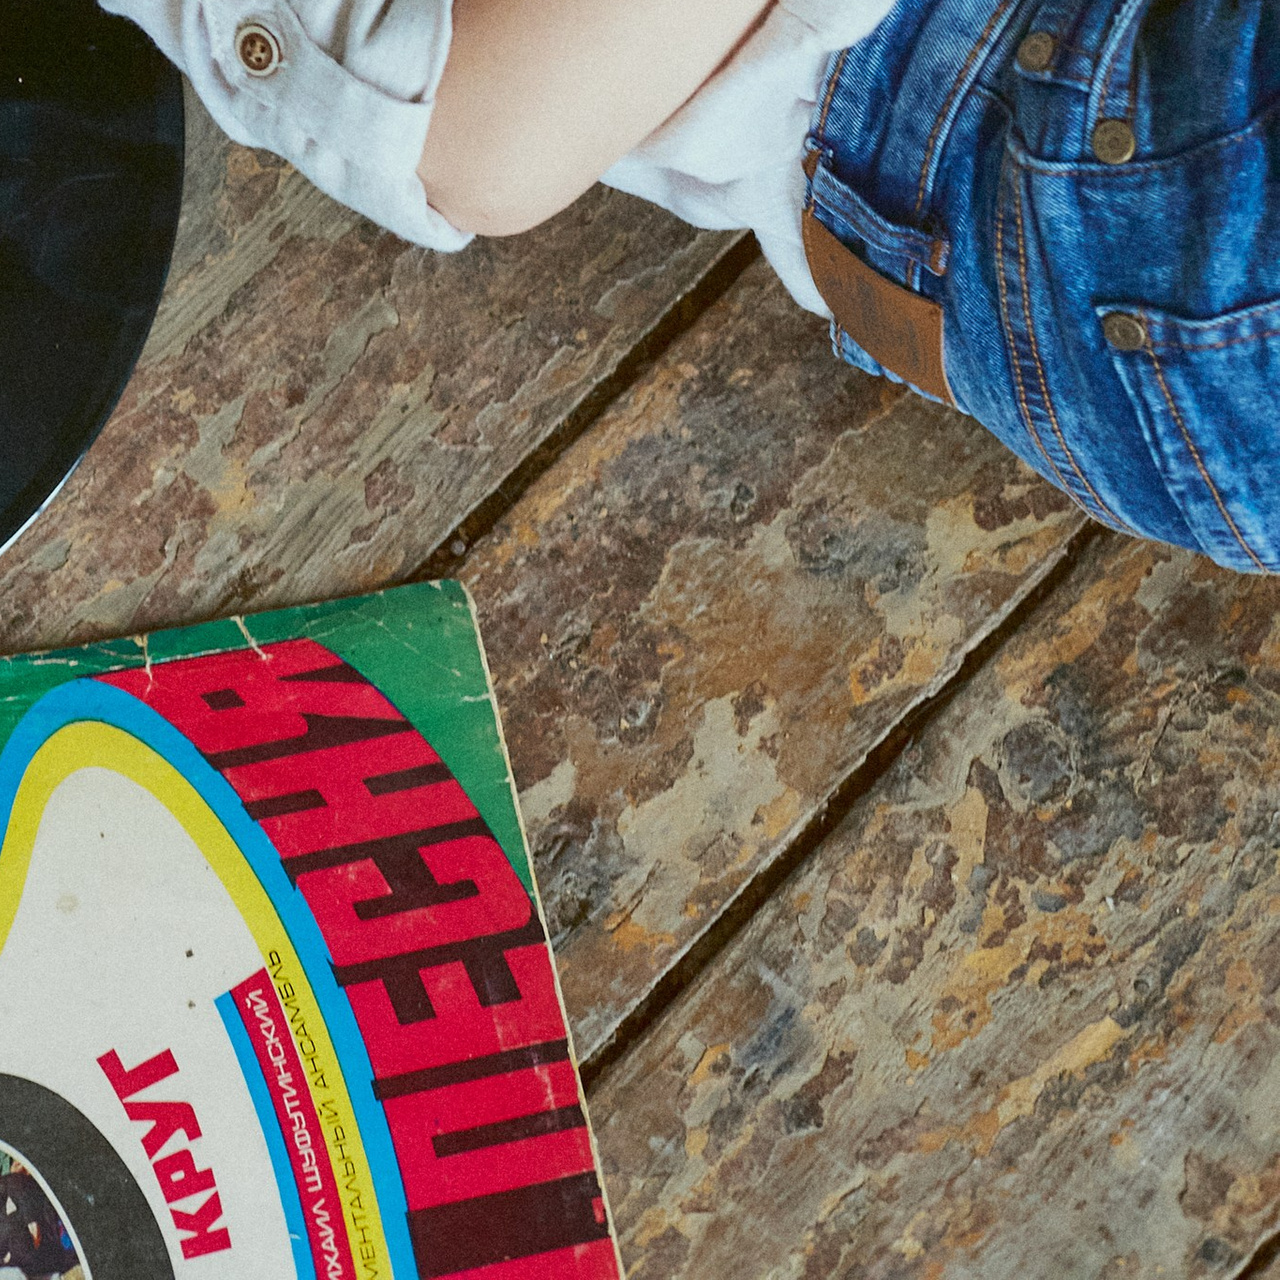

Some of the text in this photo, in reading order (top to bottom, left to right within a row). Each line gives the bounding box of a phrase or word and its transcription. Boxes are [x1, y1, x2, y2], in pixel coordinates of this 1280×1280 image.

[246, 988, 322, 1193] ШУФУТИНСКИЙ
[268, 950, 330, 1089] АНСАМБЛЬ
[96, 1048, 231, 1262] КРУГ
